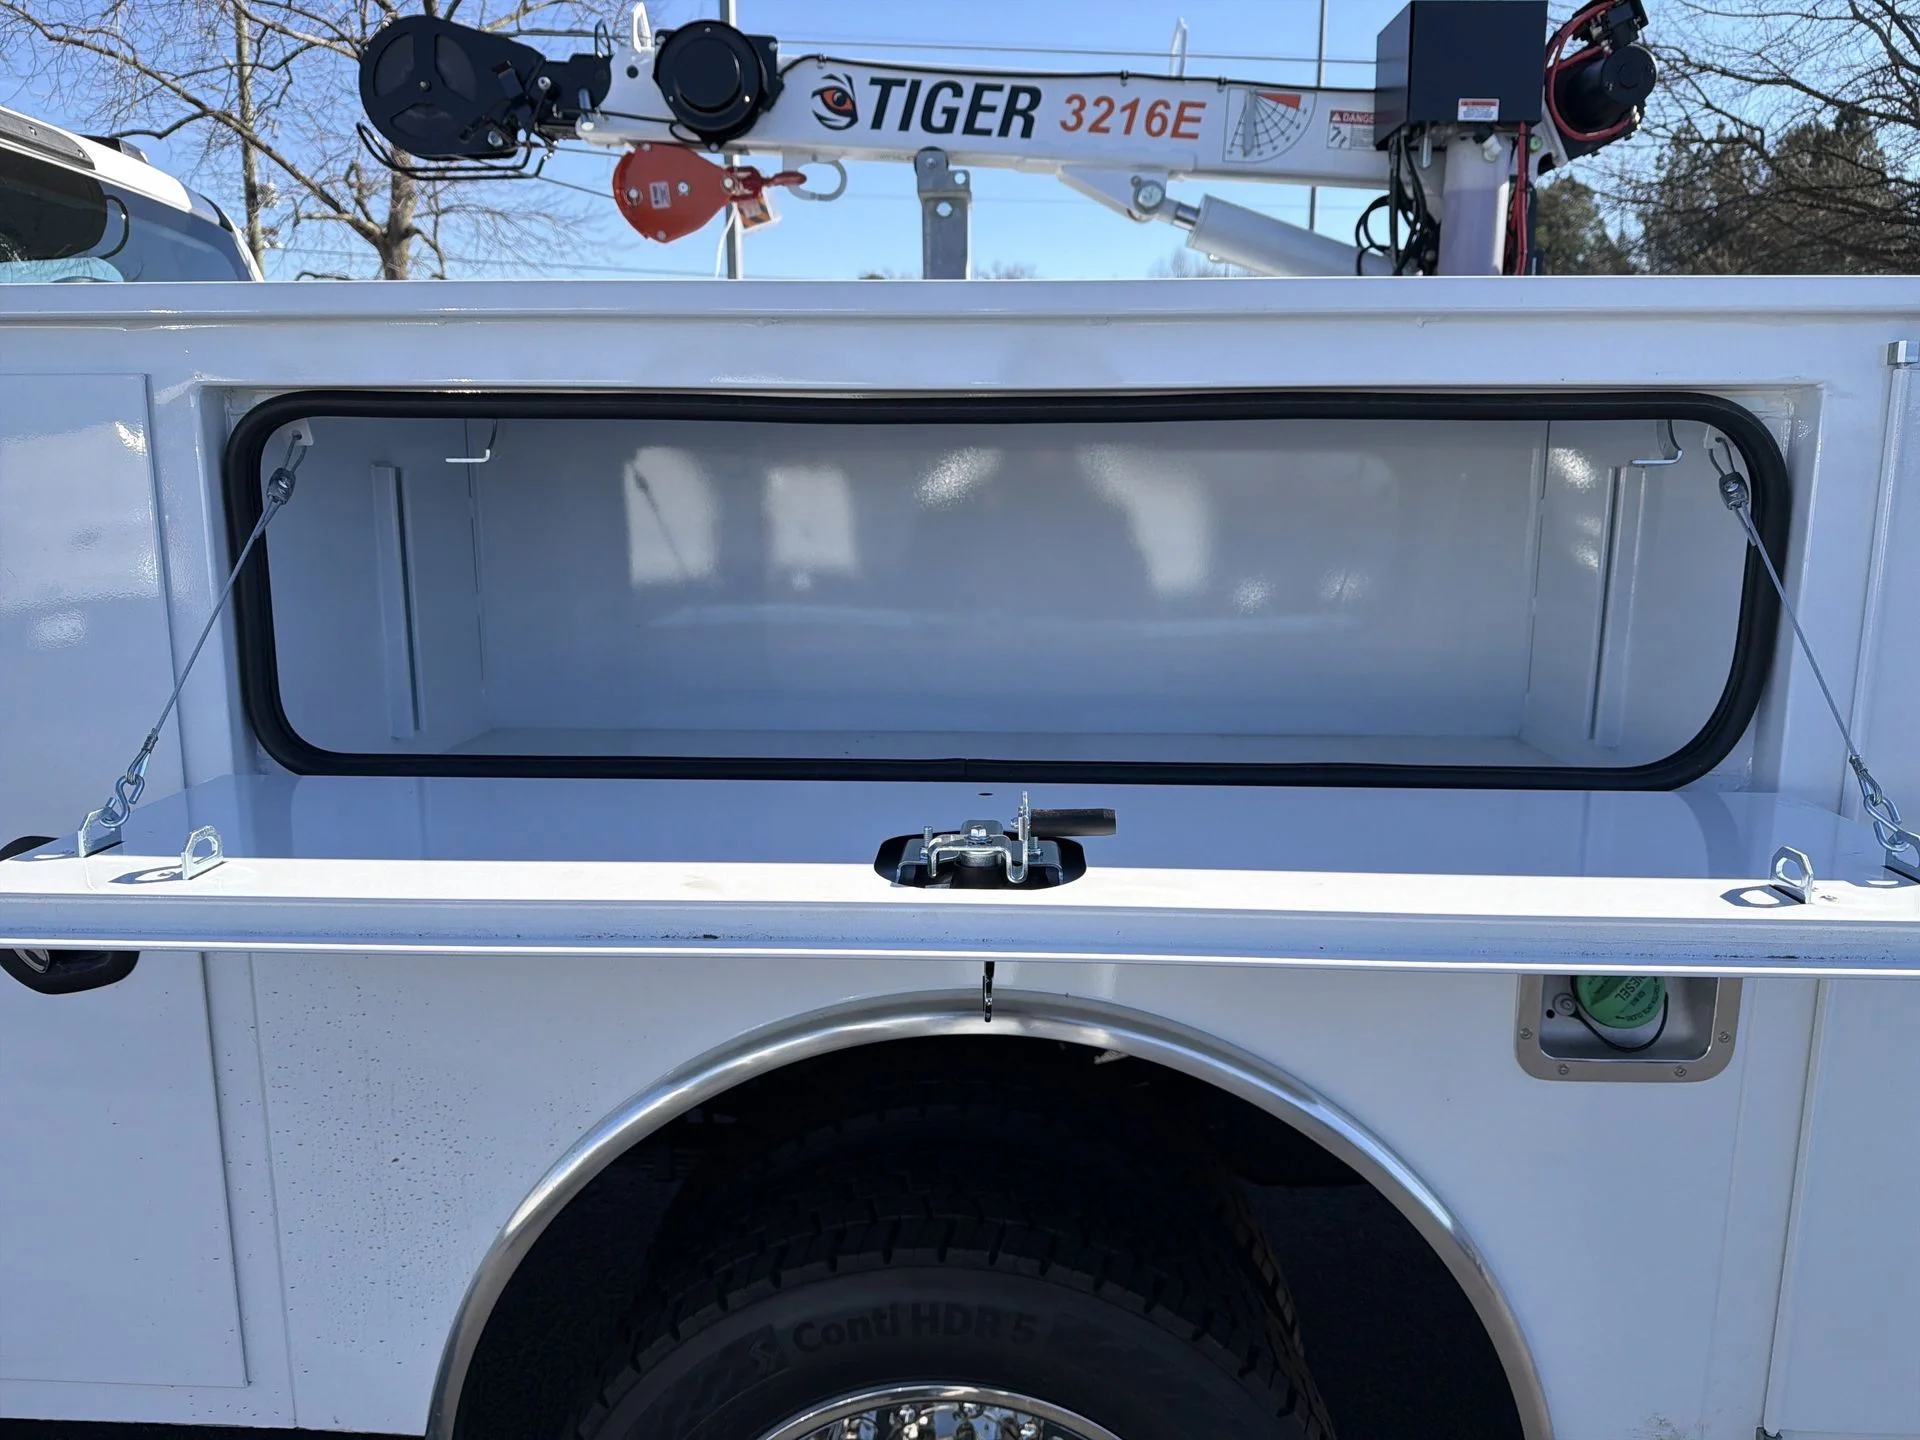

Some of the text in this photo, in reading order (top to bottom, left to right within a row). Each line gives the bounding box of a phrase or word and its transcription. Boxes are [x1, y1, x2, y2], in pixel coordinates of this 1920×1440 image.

[867, 76, 1042, 139] TIGER
[1059, 93, 1207, 140] 3216E
[1342, 112, 1376, 124] DANGE
[792, 1301, 1039, 1353] Conti HDR 5
